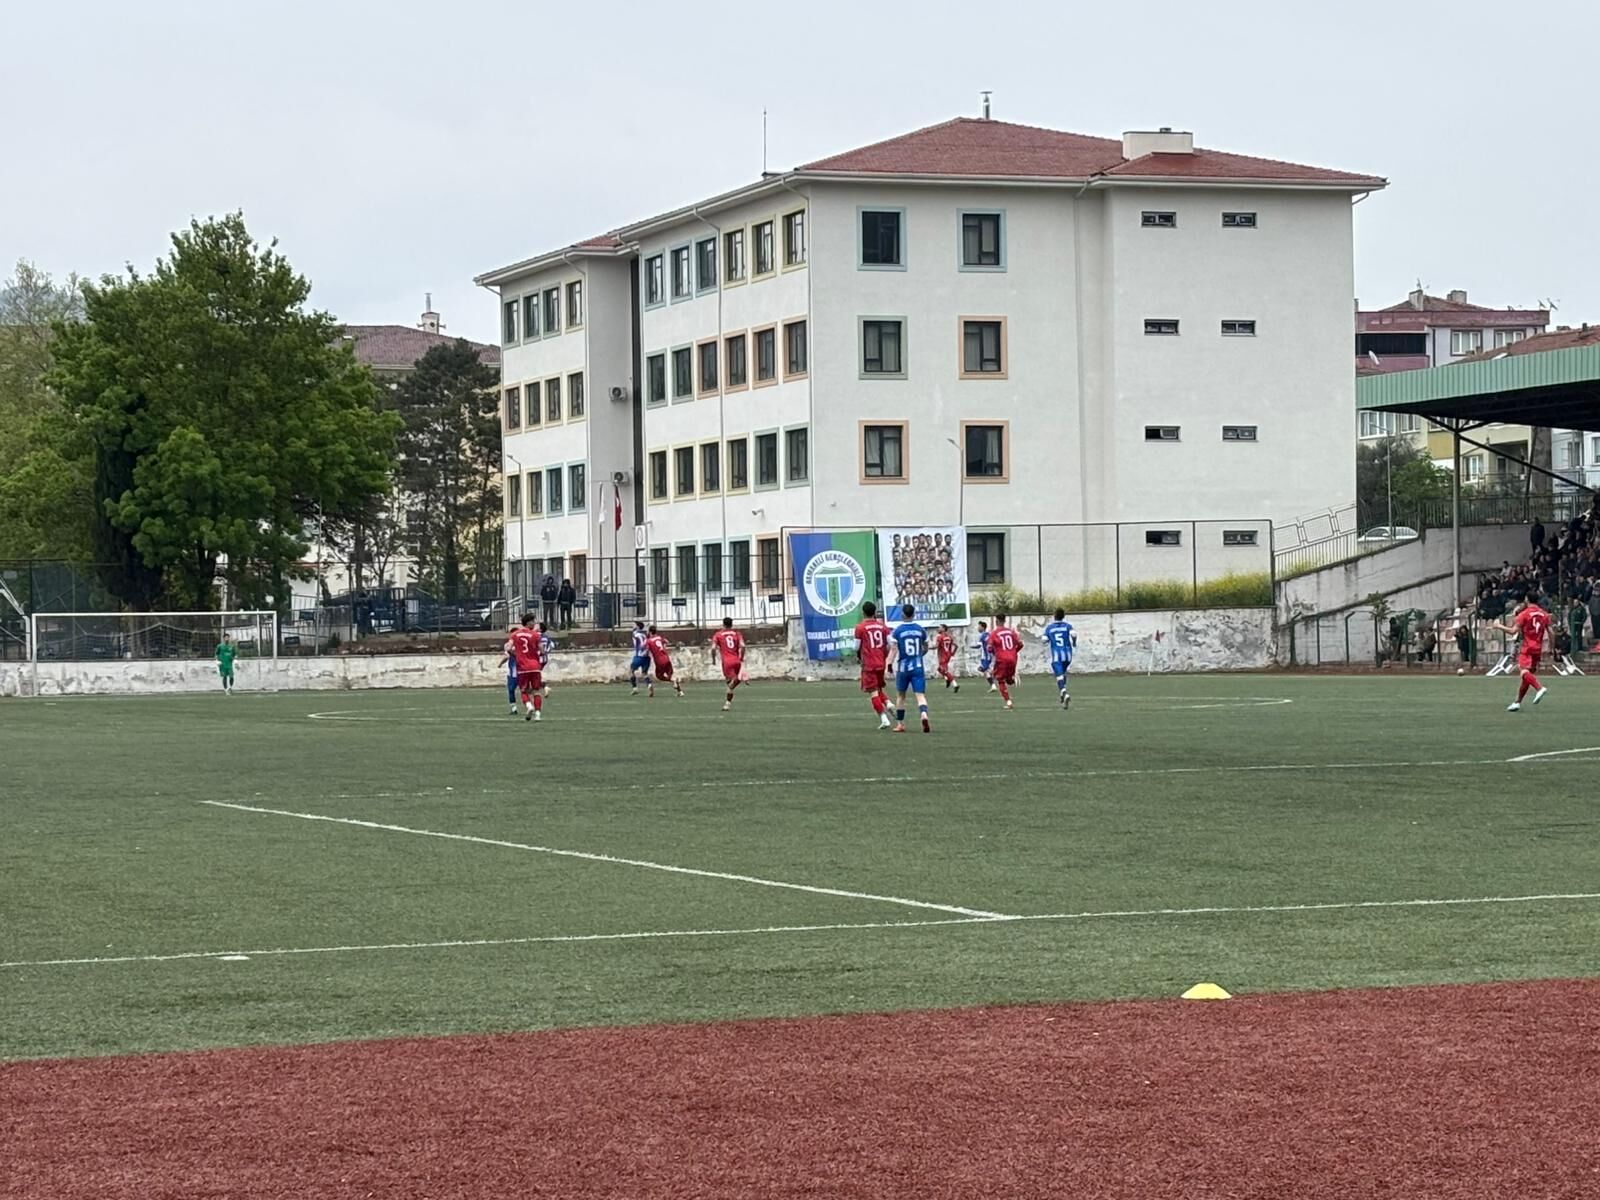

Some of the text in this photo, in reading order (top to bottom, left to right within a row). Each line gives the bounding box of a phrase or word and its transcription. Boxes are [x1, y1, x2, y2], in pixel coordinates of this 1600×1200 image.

[520, 637, 529, 653] 3
[726, 635, 734, 648] 8
[868, 630, 883, 648] 19
[905, 638, 919, 656] 61
[1000, 635, 1013, 651] 10
[1055, 633, 1064, 646] 5
